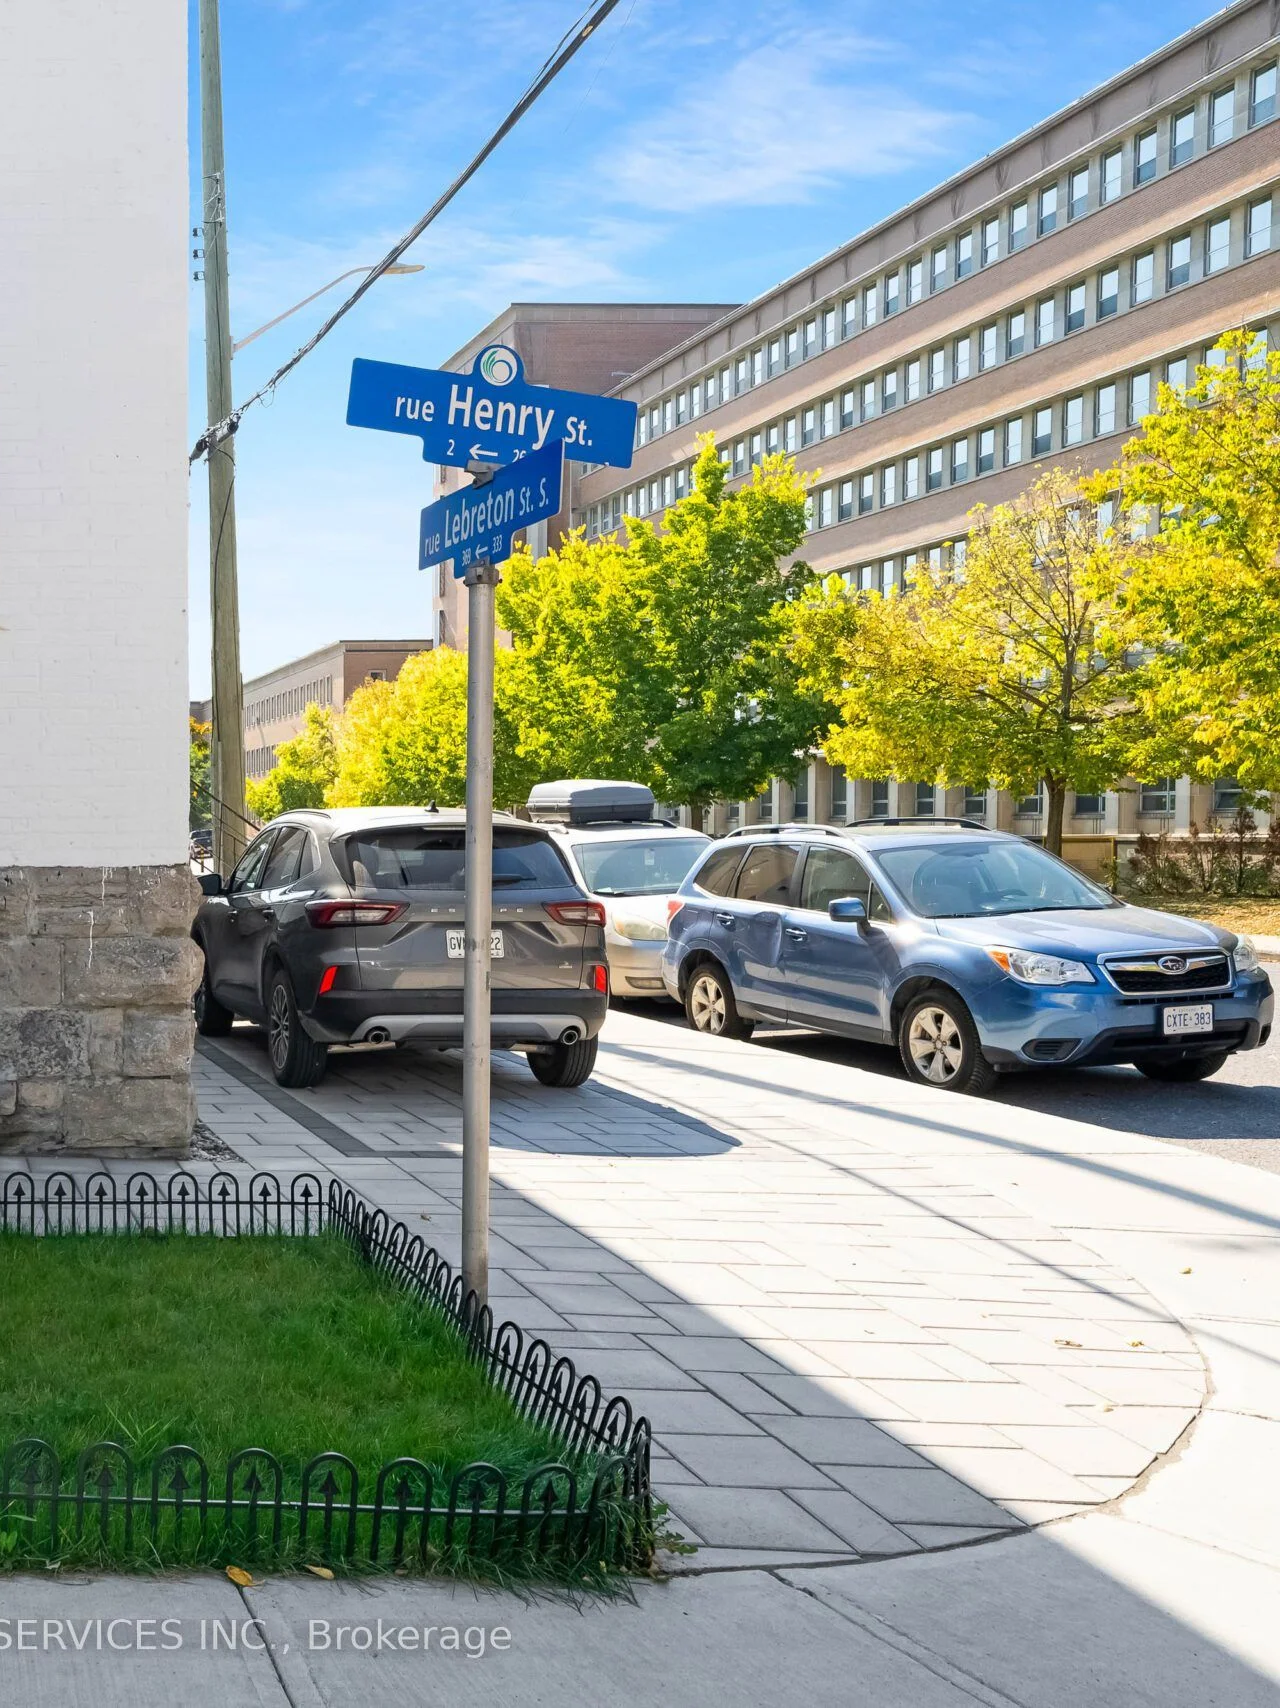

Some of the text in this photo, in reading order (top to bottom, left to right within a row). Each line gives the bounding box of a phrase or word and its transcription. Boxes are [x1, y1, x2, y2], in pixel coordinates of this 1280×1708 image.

[394, 384, 593, 451] rue Henry St.
[446, 439, 455, 456] 2
[424, 477, 549, 557] rue Lebreton St. S.
[1166, 1011, 1211, 1028] CXTE 383
